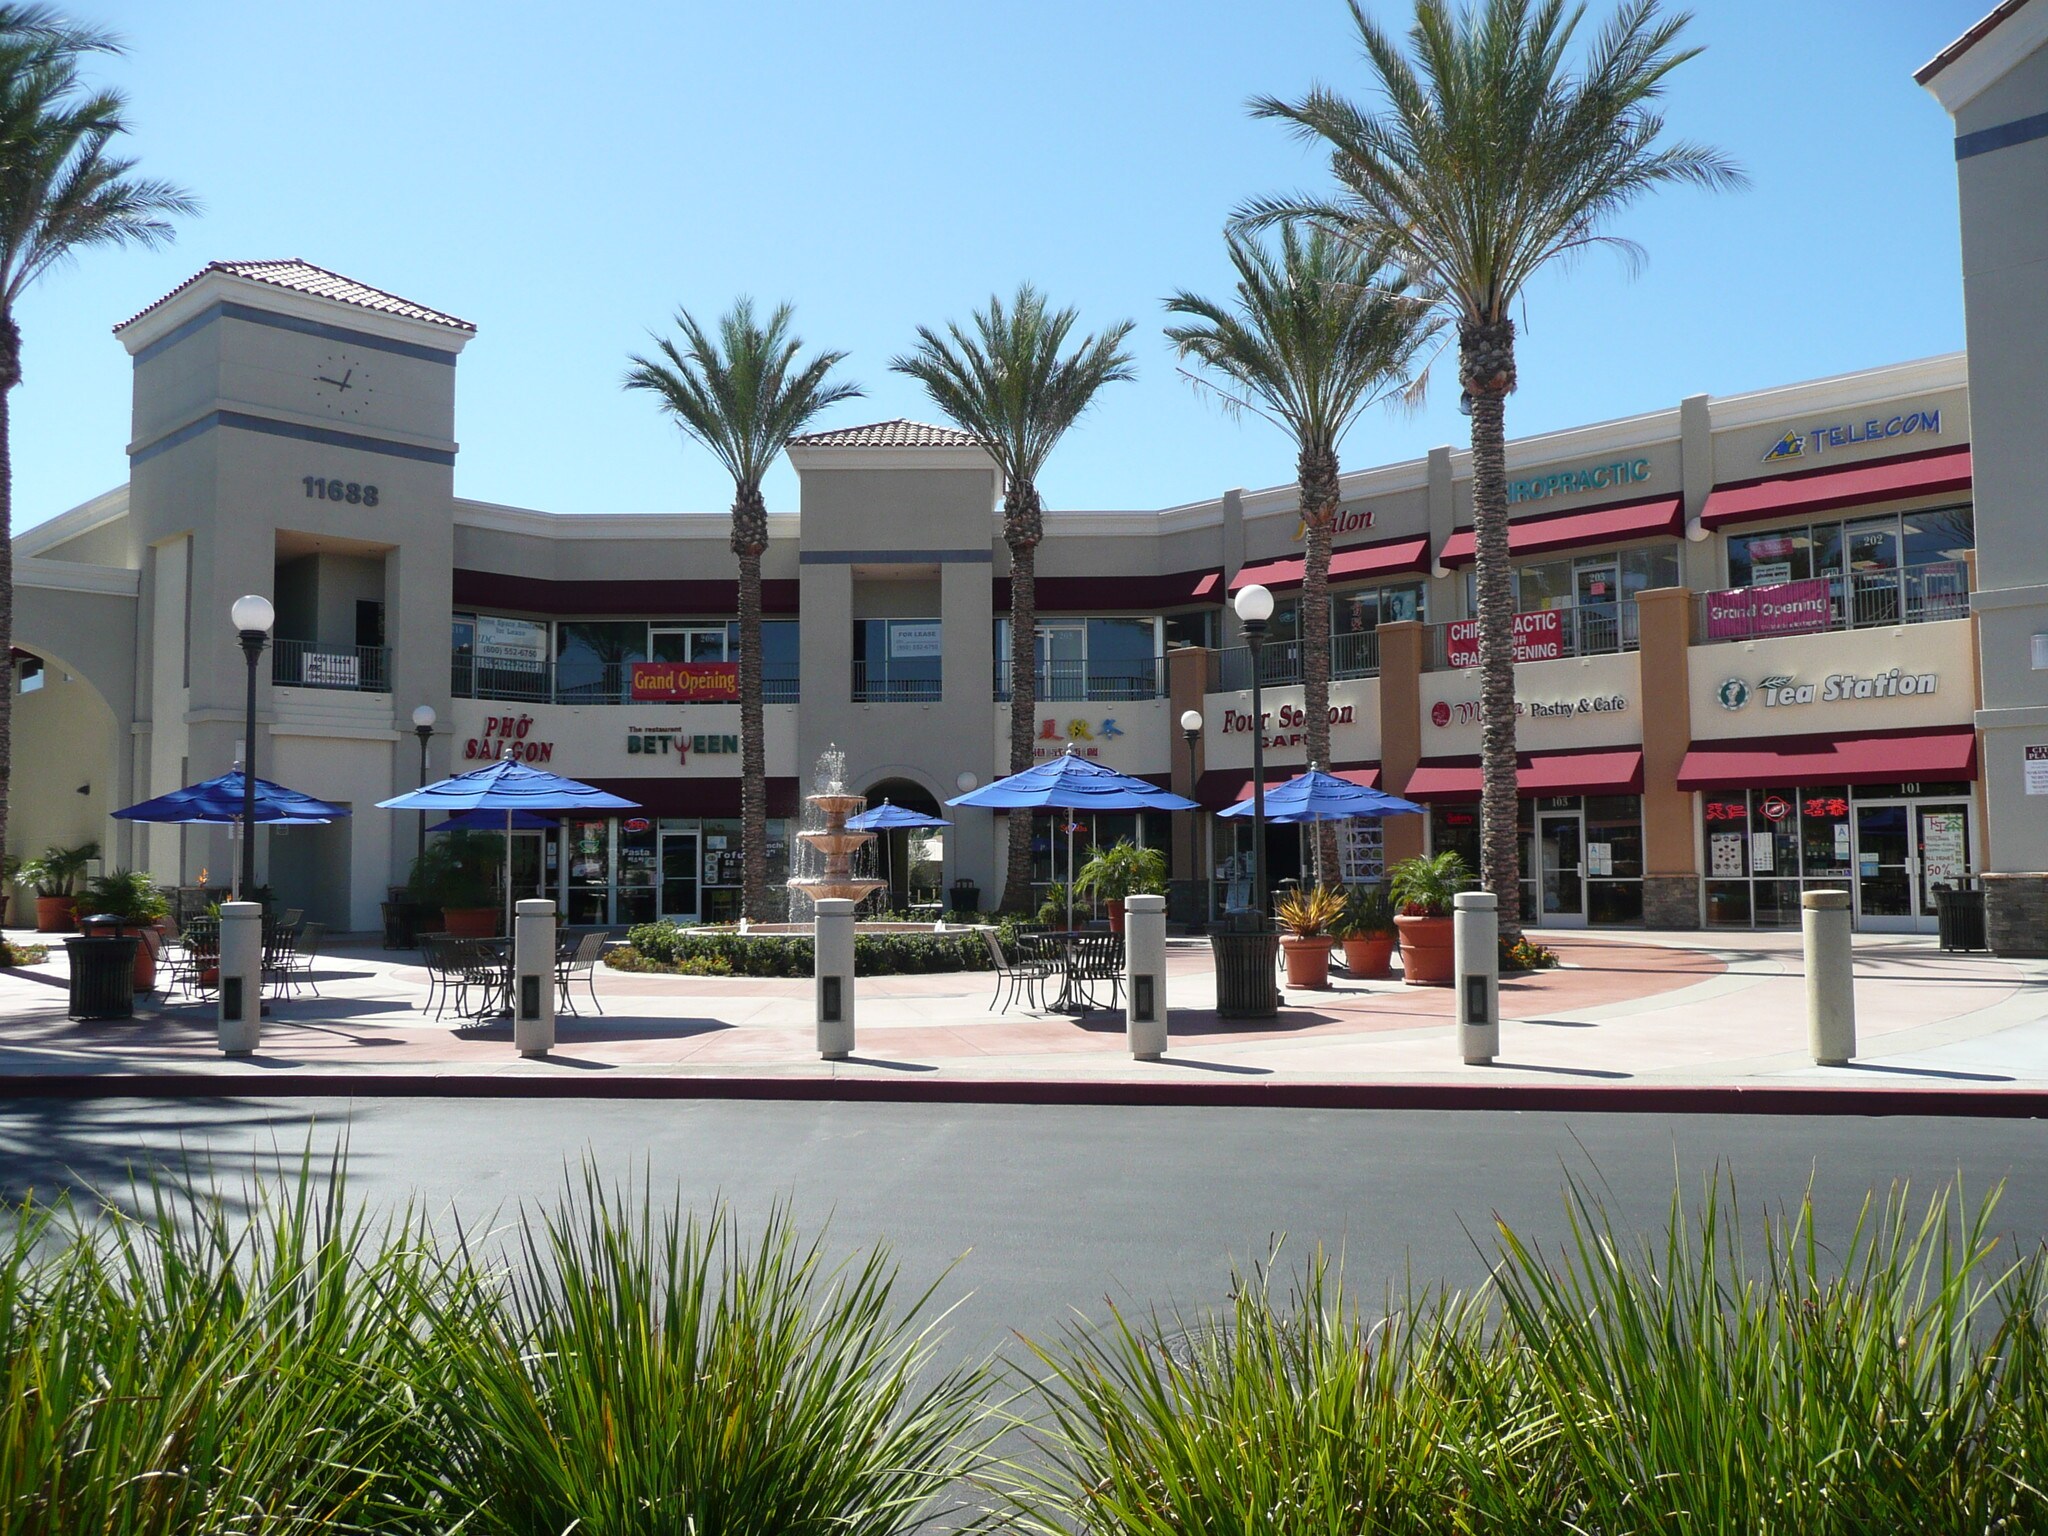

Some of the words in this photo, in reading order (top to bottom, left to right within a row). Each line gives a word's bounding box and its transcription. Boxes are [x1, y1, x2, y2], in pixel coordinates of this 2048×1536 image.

[1811, 410, 1940, 452] TELECOM
[302, 476, 379, 507] 11688
[1507, 459, 1649, 503] IROPRACTIC
[1863, 534, 1883, 546] 202
[1711, 604, 1757, 620] Grand
[1762, 598, 1826, 617] Opening
[1512, 642, 1557, 660] PENING
[634, 670, 674, 689] Grand
[679, 671, 736, 694] Opening
[1757, 675, 1816, 707] Tea
[1822, 668, 1937, 701] Station
[1279, 705, 1353, 728] Seon
[1530, 702, 1574, 718] Pastry
[1577, 698, 1590, 713] &
[1039, 718, 1124, 741] 夏秋冬
[465, 738, 554, 762] SAIGON
[1901, 782, 1920, 794] 101
[1552, 797, 1568, 807] 103
[1838, 828, 1846, 836] A
[716, 851, 744, 859] Tofu
[1927, 863, 1951, 876] 50%
